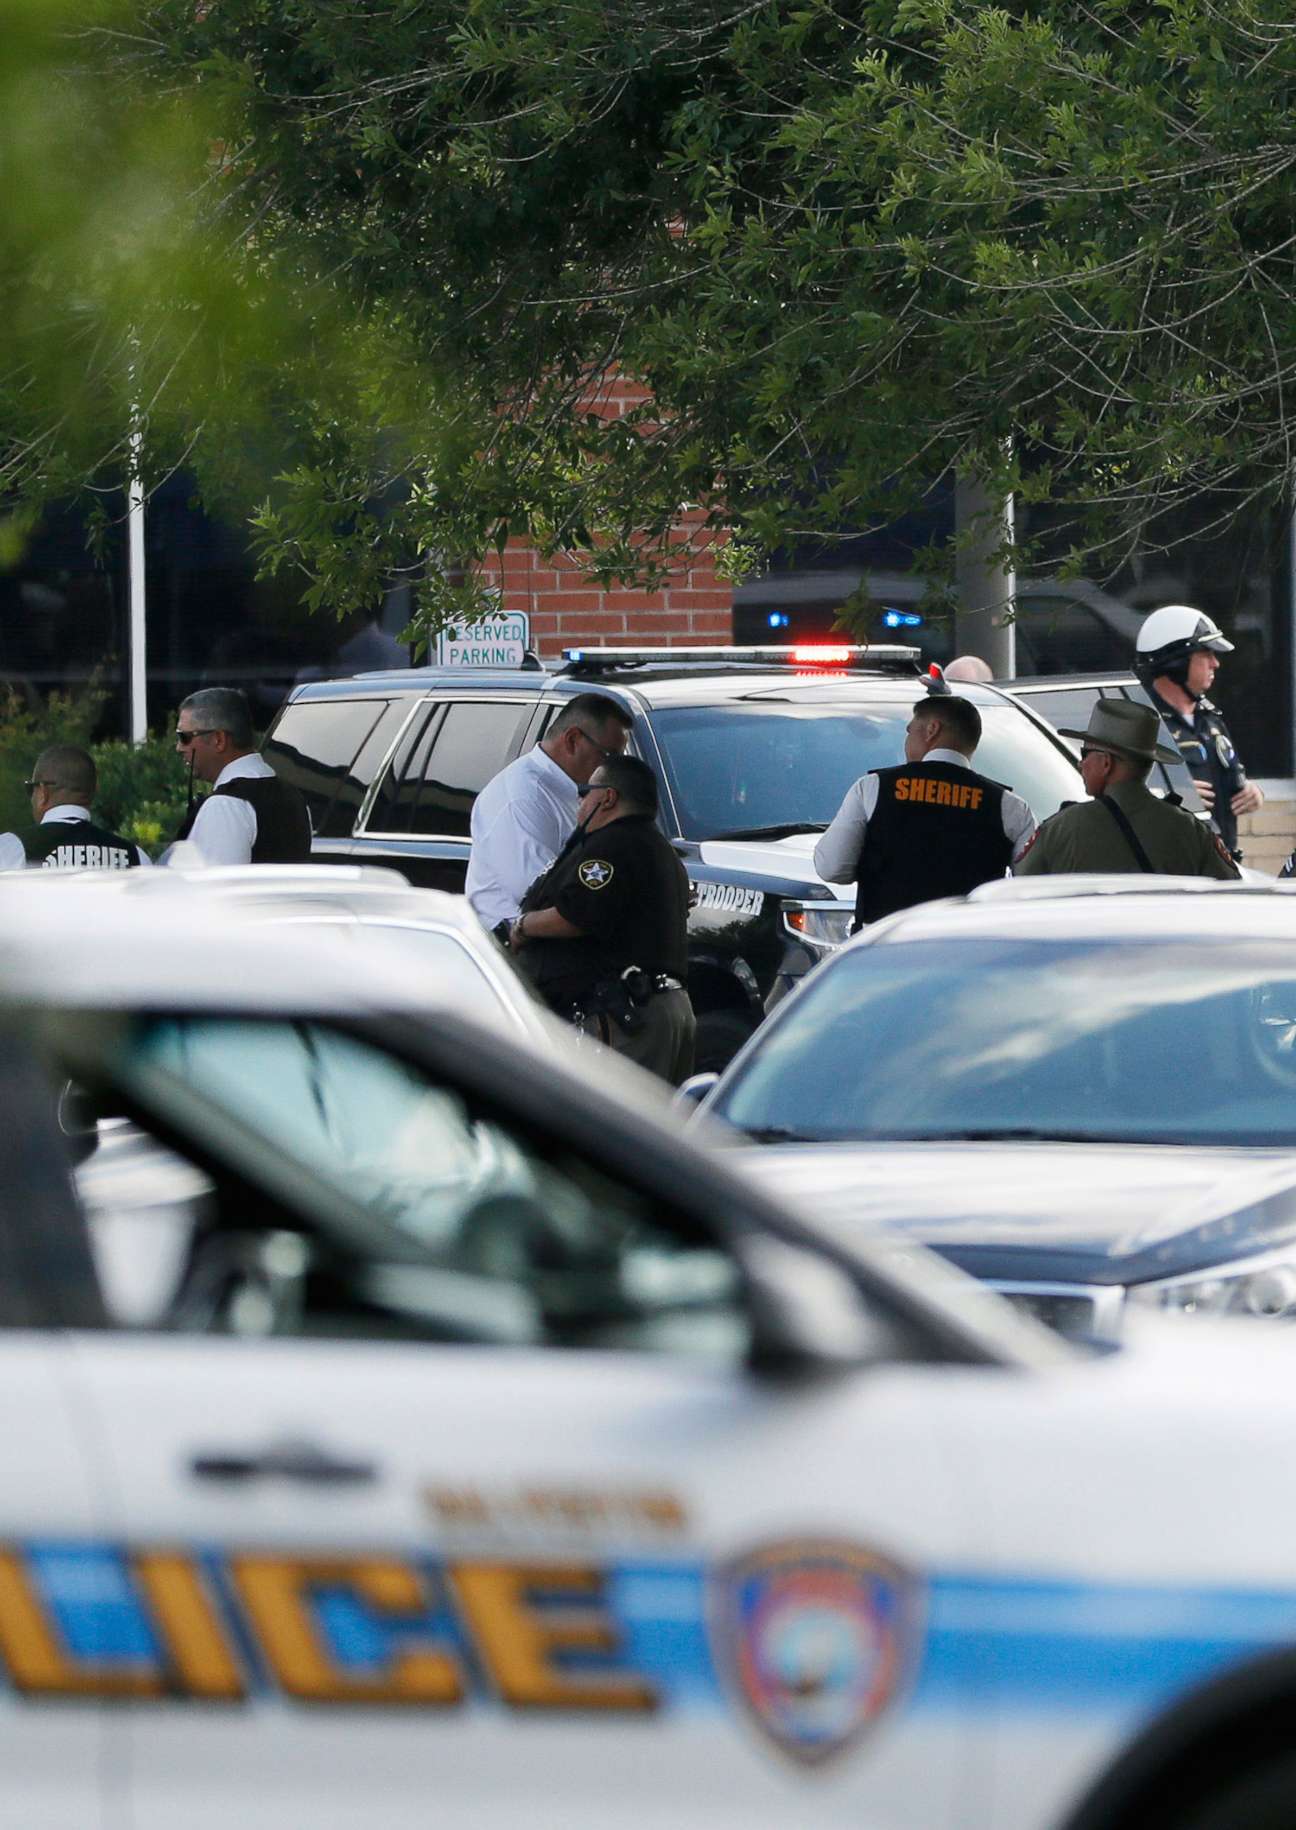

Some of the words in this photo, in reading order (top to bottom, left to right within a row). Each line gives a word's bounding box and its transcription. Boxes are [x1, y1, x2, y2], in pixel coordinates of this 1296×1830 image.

[450, 648, 516, 665] PARKING
[895, 778, 983, 810] SHERIFF
[696, 883, 764, 916] TROOPER
